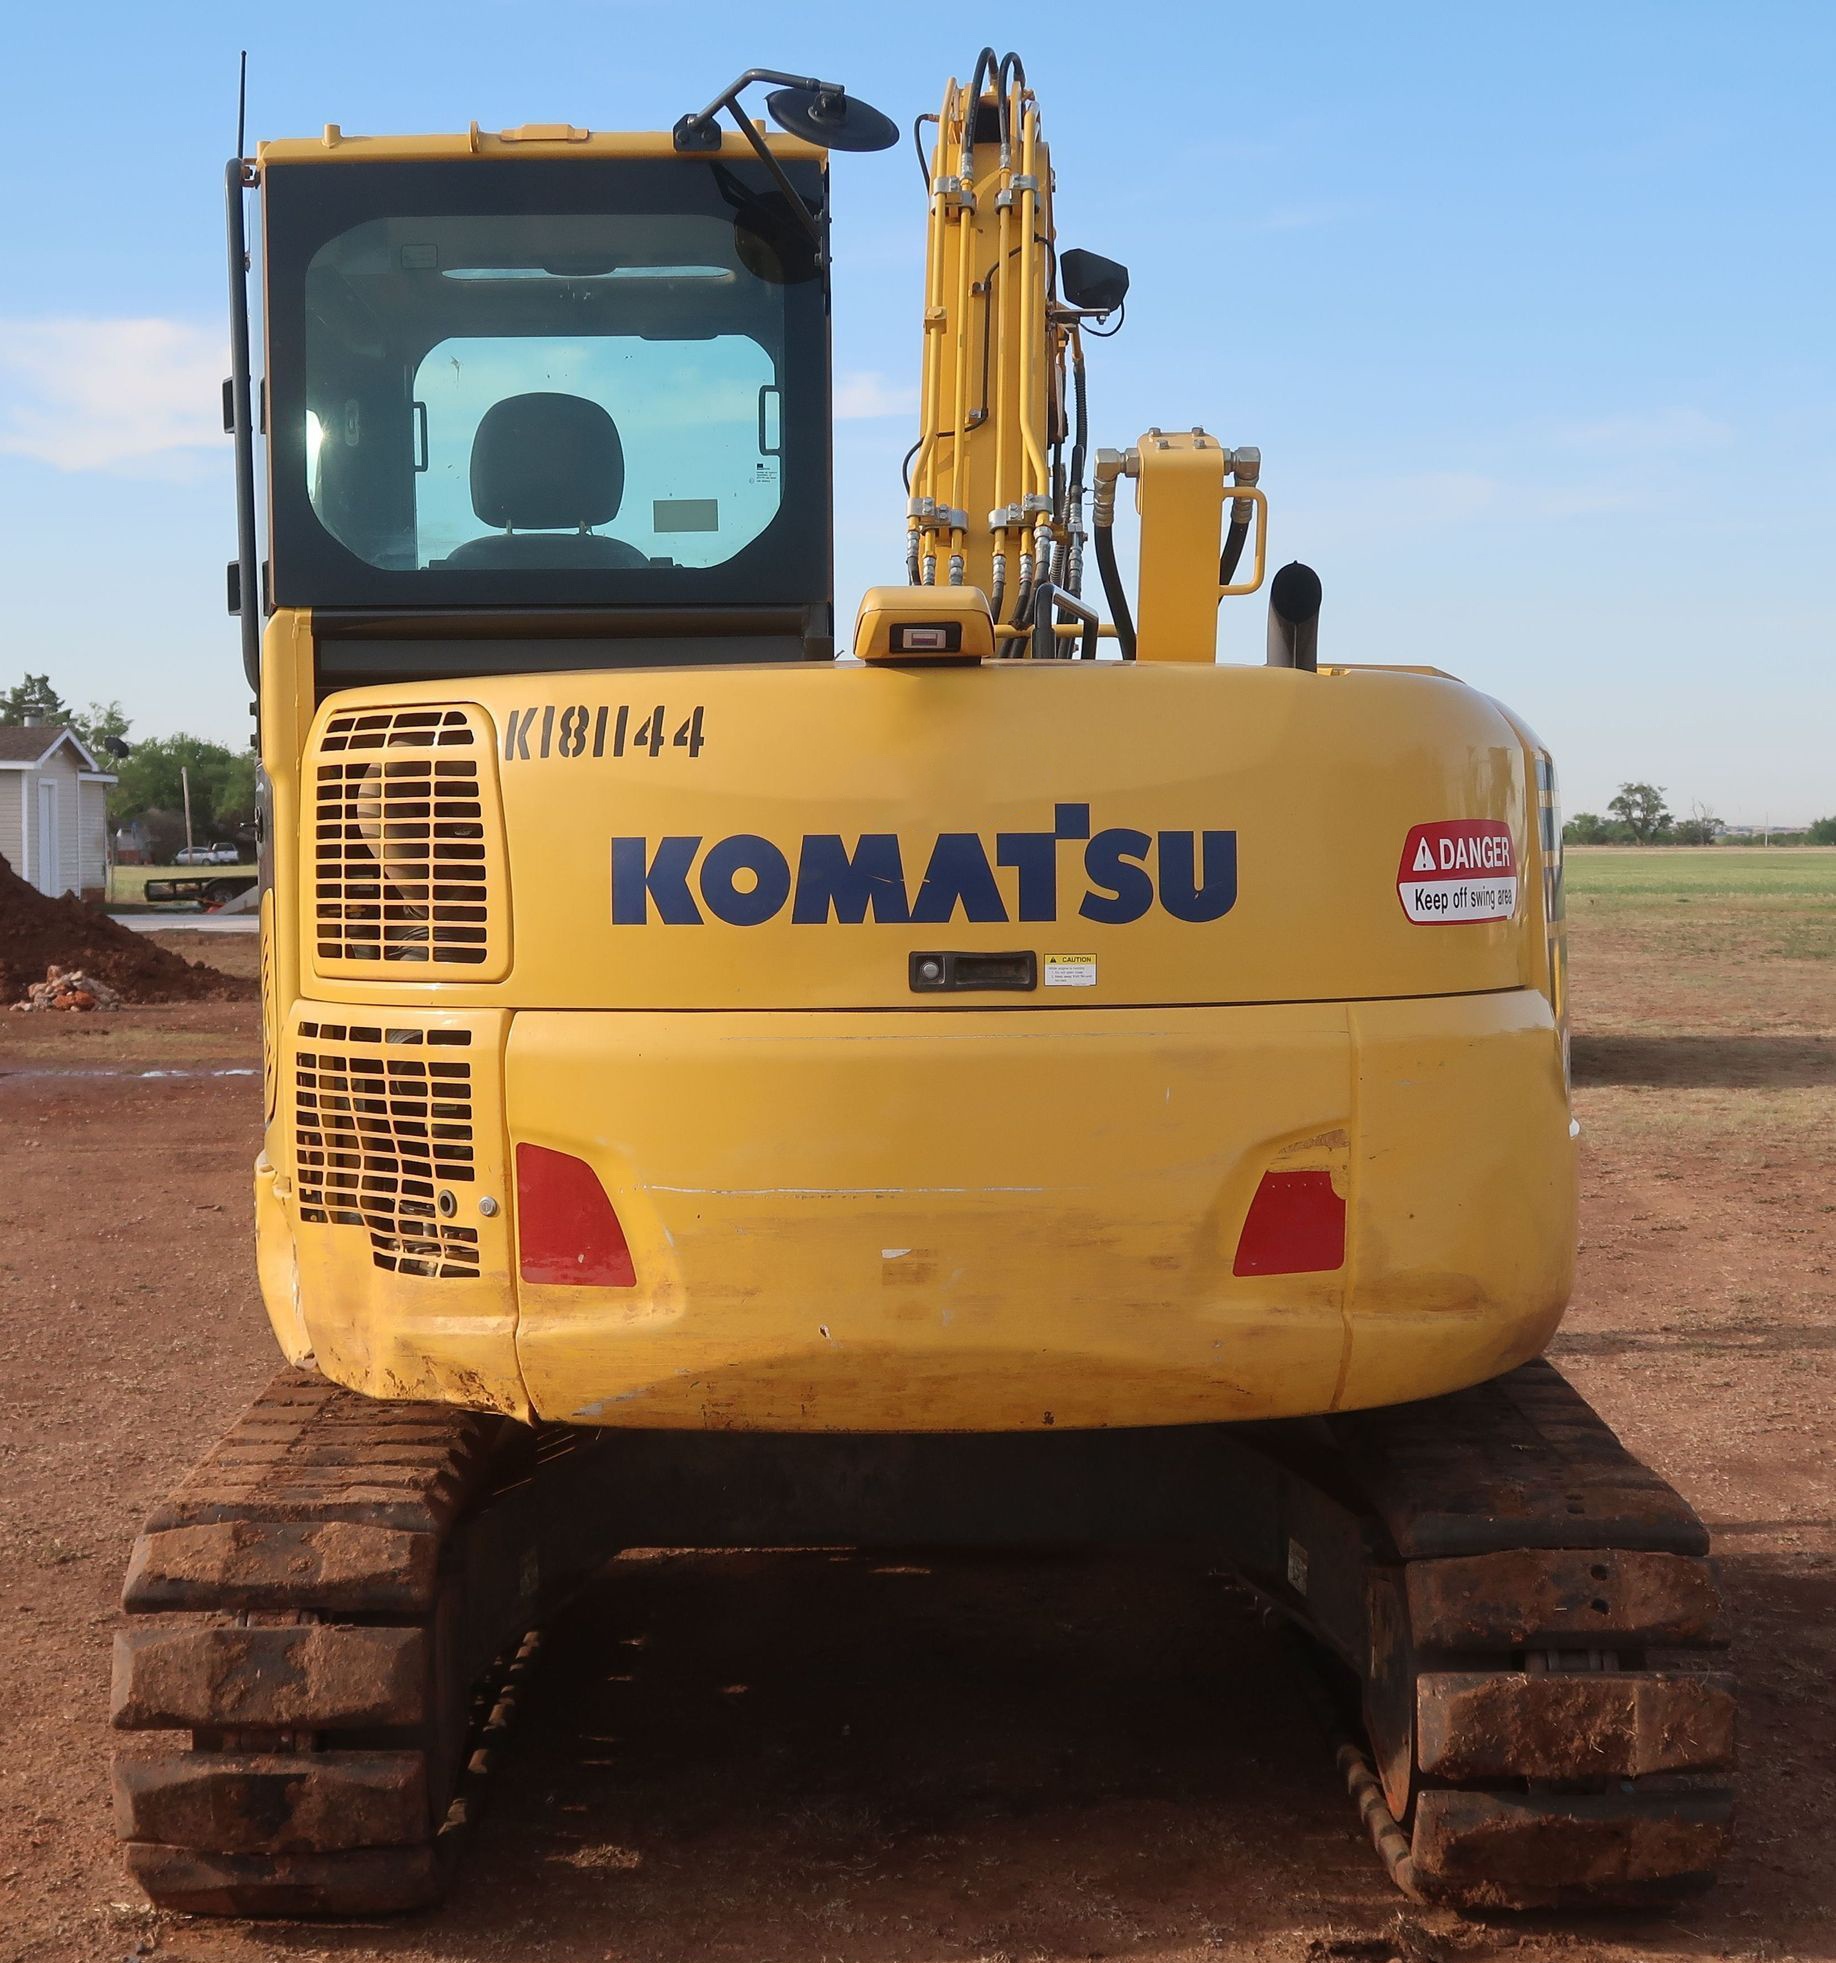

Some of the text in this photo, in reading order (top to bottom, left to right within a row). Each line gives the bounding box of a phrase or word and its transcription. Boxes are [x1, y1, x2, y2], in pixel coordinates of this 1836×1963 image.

[505, 705, 704, 761] K181144
[611, 803, 1237, 926] KOMATSU
[1439, 836, 1511, 870] DANGER
[1415, 886, 1512, 914] Keep off swing area
